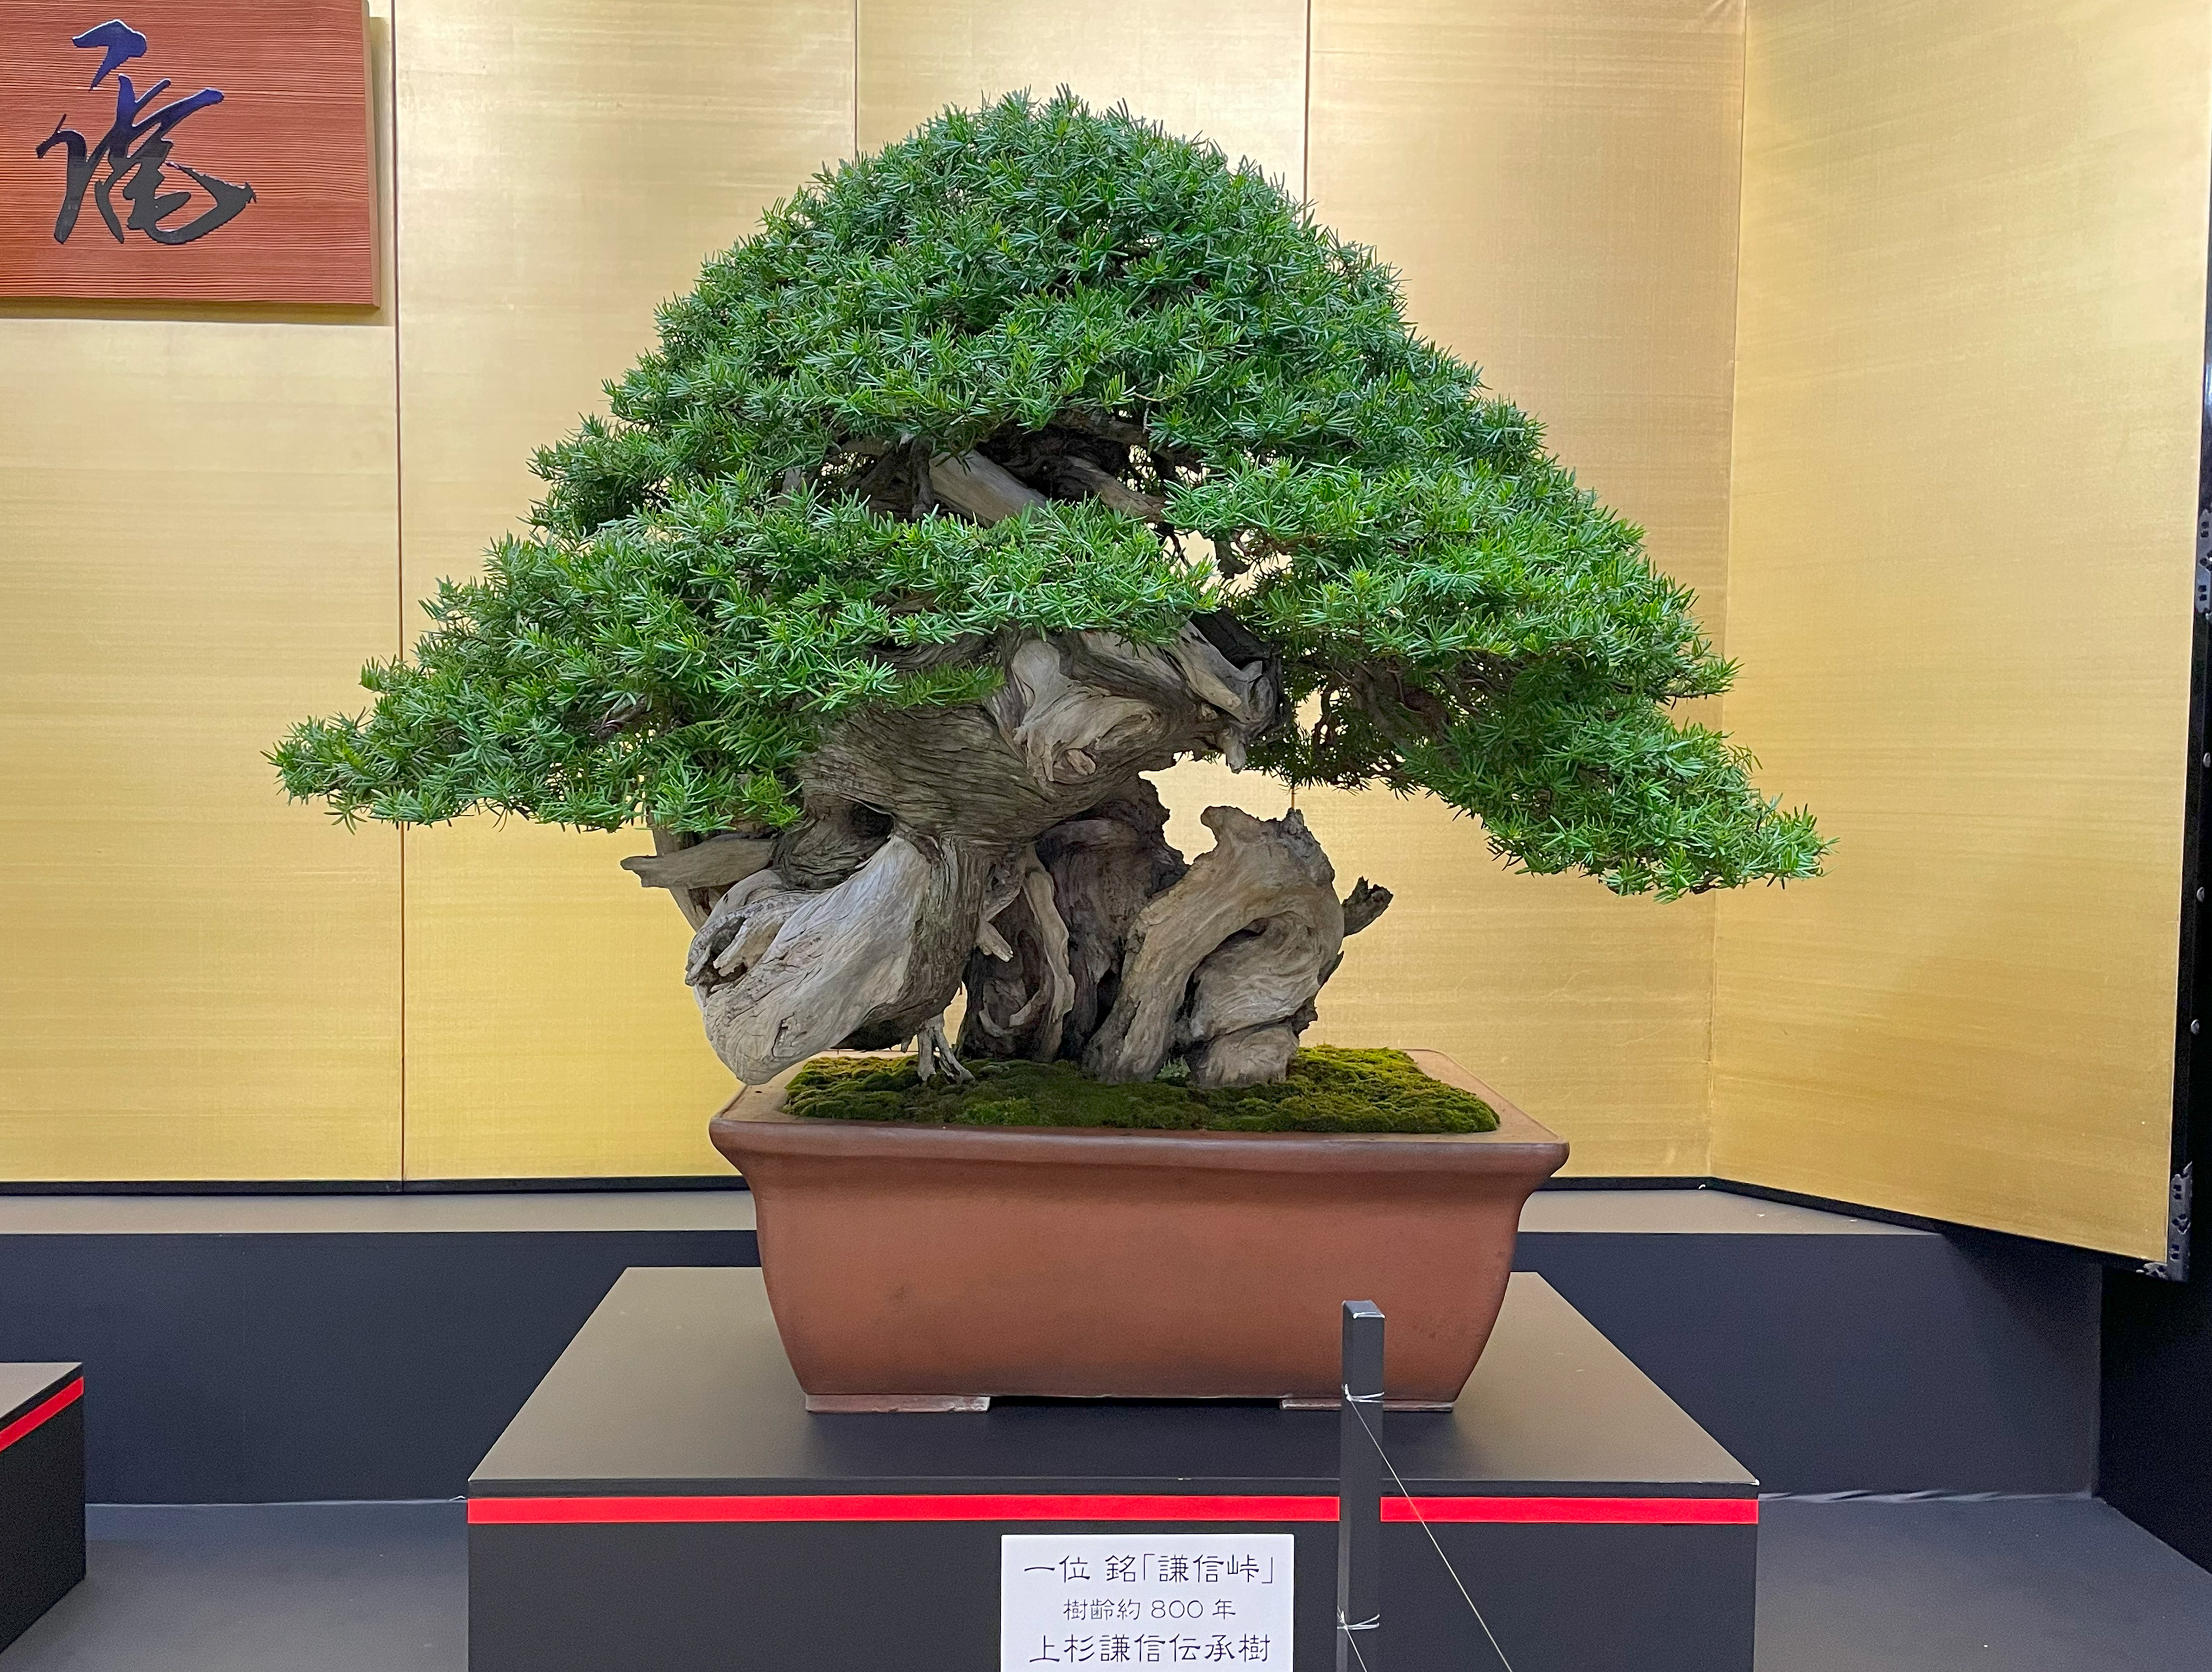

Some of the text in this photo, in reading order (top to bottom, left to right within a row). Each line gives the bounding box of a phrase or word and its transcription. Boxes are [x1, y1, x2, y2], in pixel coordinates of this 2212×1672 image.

[1024, 1553, 1273, 1584] 一位 銘「謙信峠」
[1063, 1598, 1236, 1621] 樹齢約 800 年
[1029, 1633, 1271, 1663] 上杉謙信伝承樹
